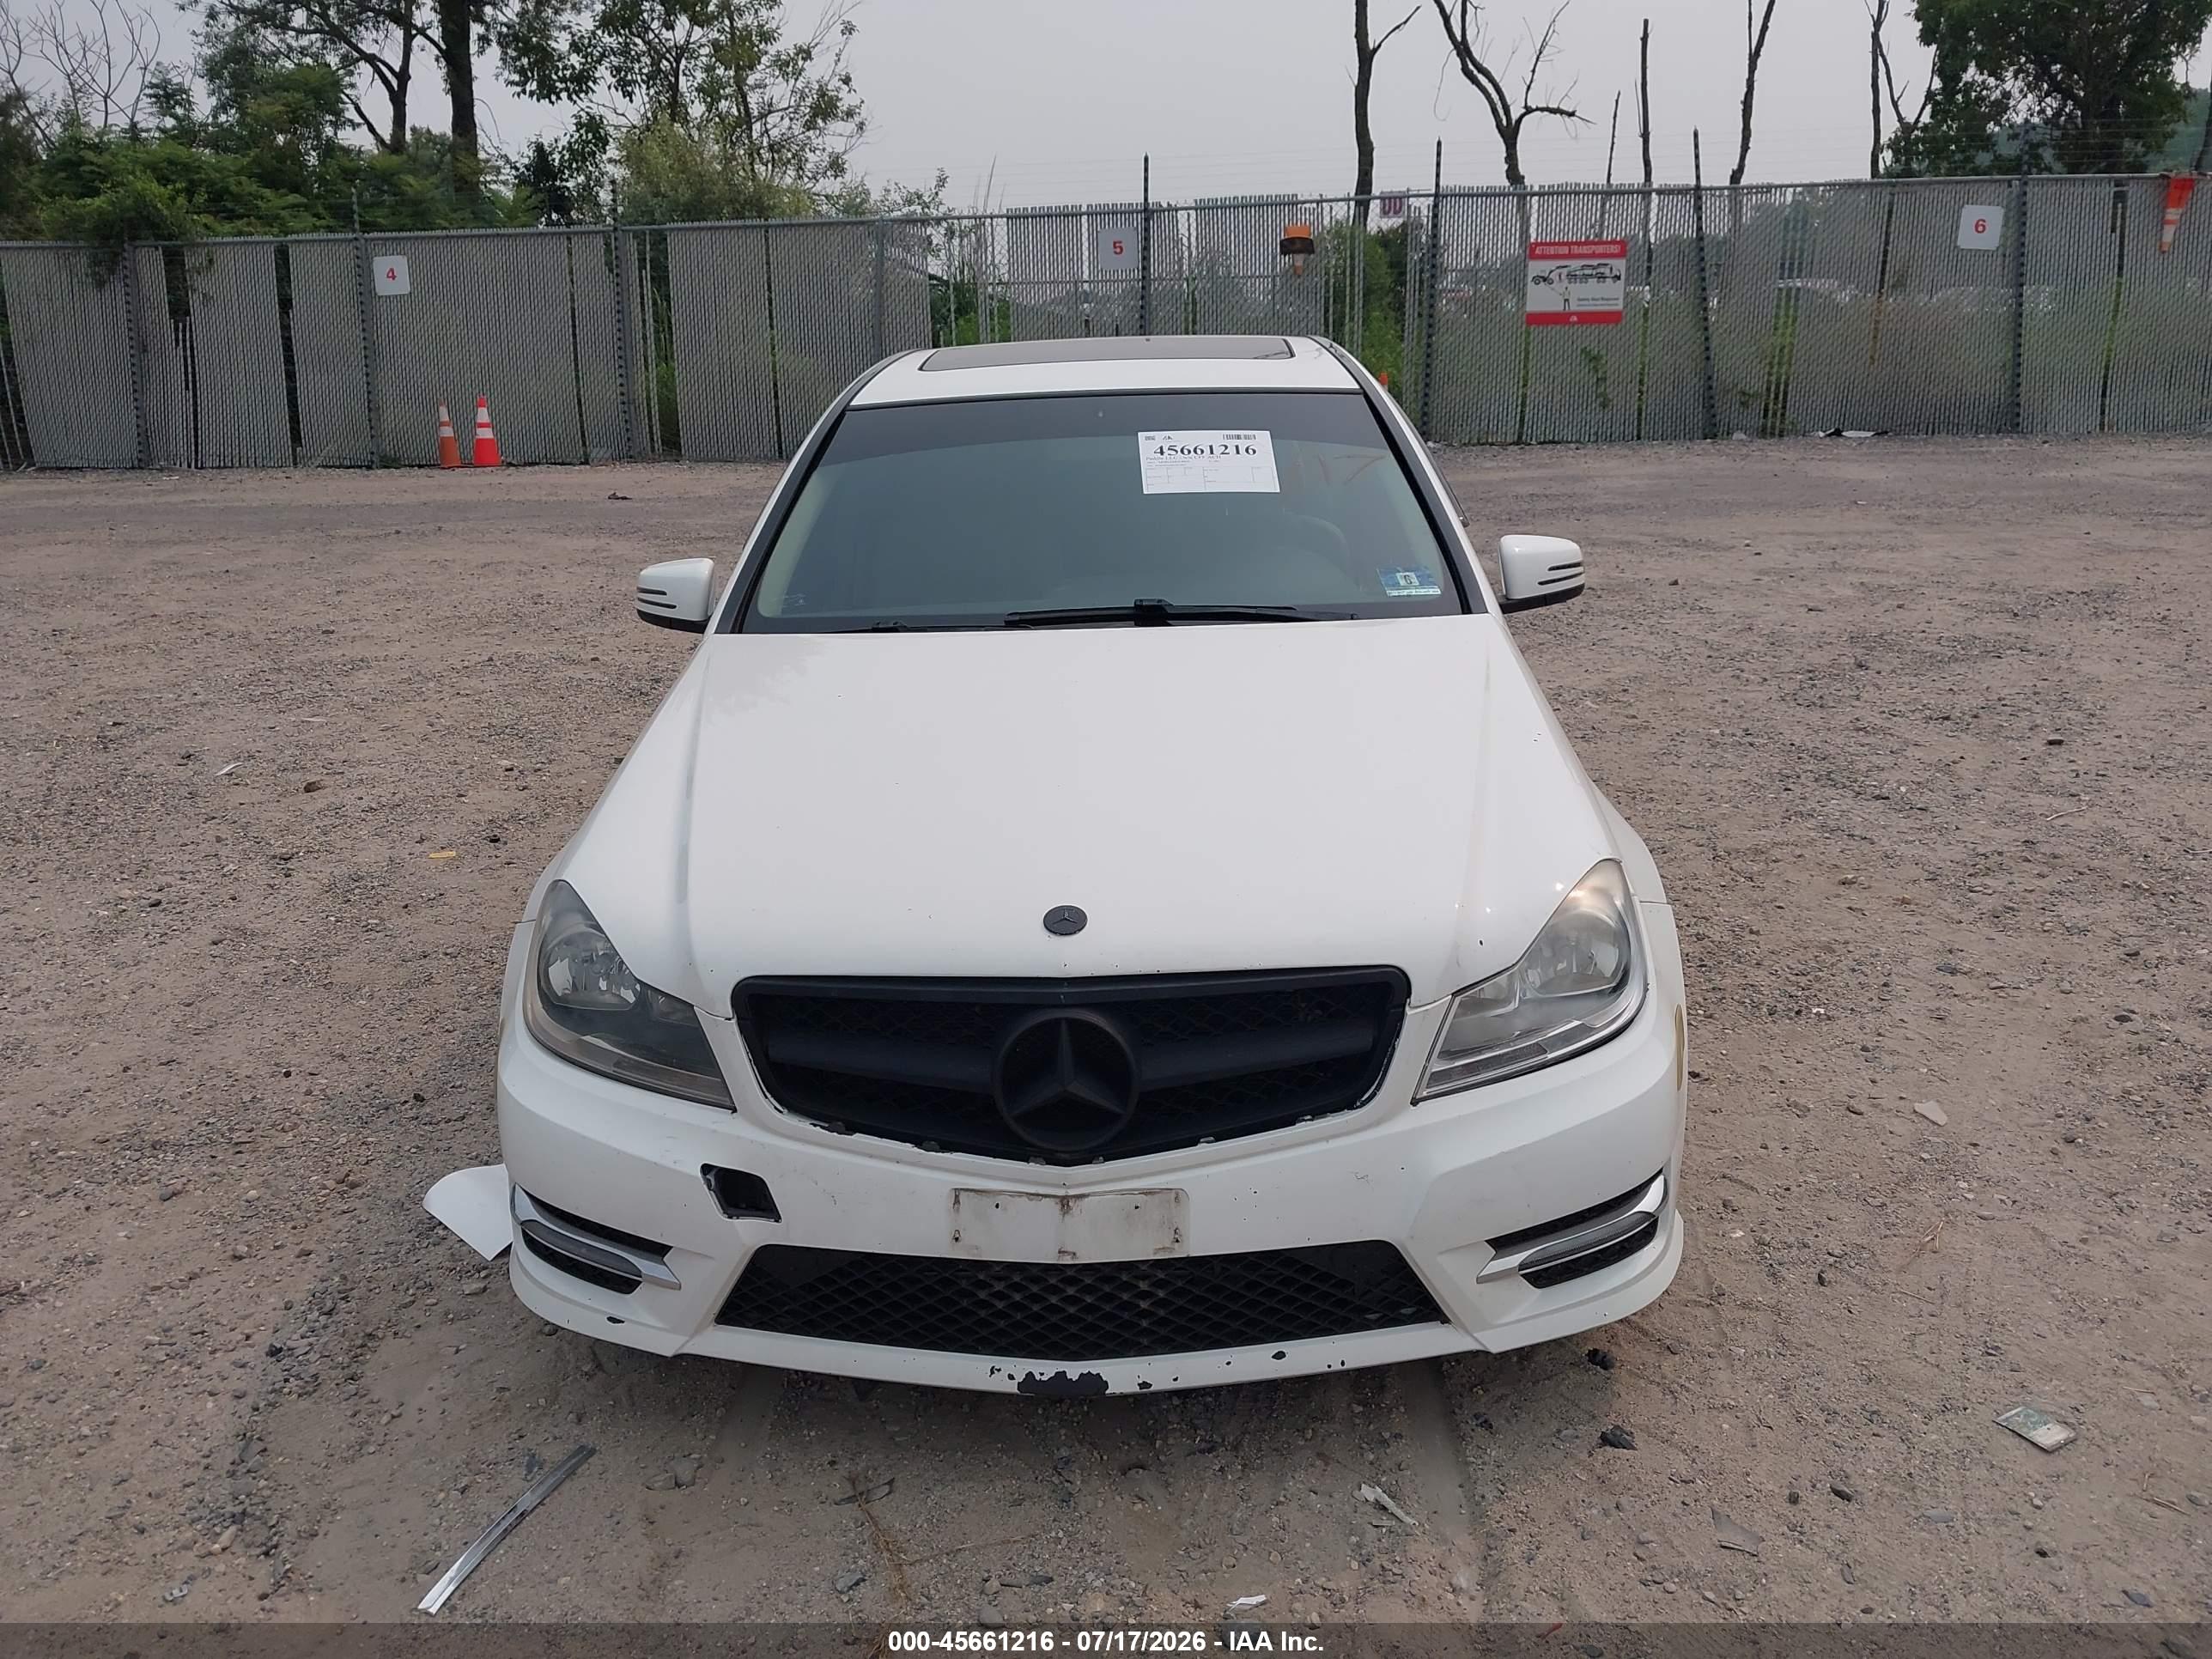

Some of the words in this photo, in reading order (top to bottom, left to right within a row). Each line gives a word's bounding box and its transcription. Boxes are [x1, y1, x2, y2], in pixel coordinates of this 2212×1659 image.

[1974, 218, 1987, 234] 6
[1112, 240, 1124, 255] 5
[1535, 246, 1569, 254] ATTENTION
[386, 267, 398, 281] 4
[1153, 443, 1257, 456] 45661216
[1404, 574, 1413, 585] 6
